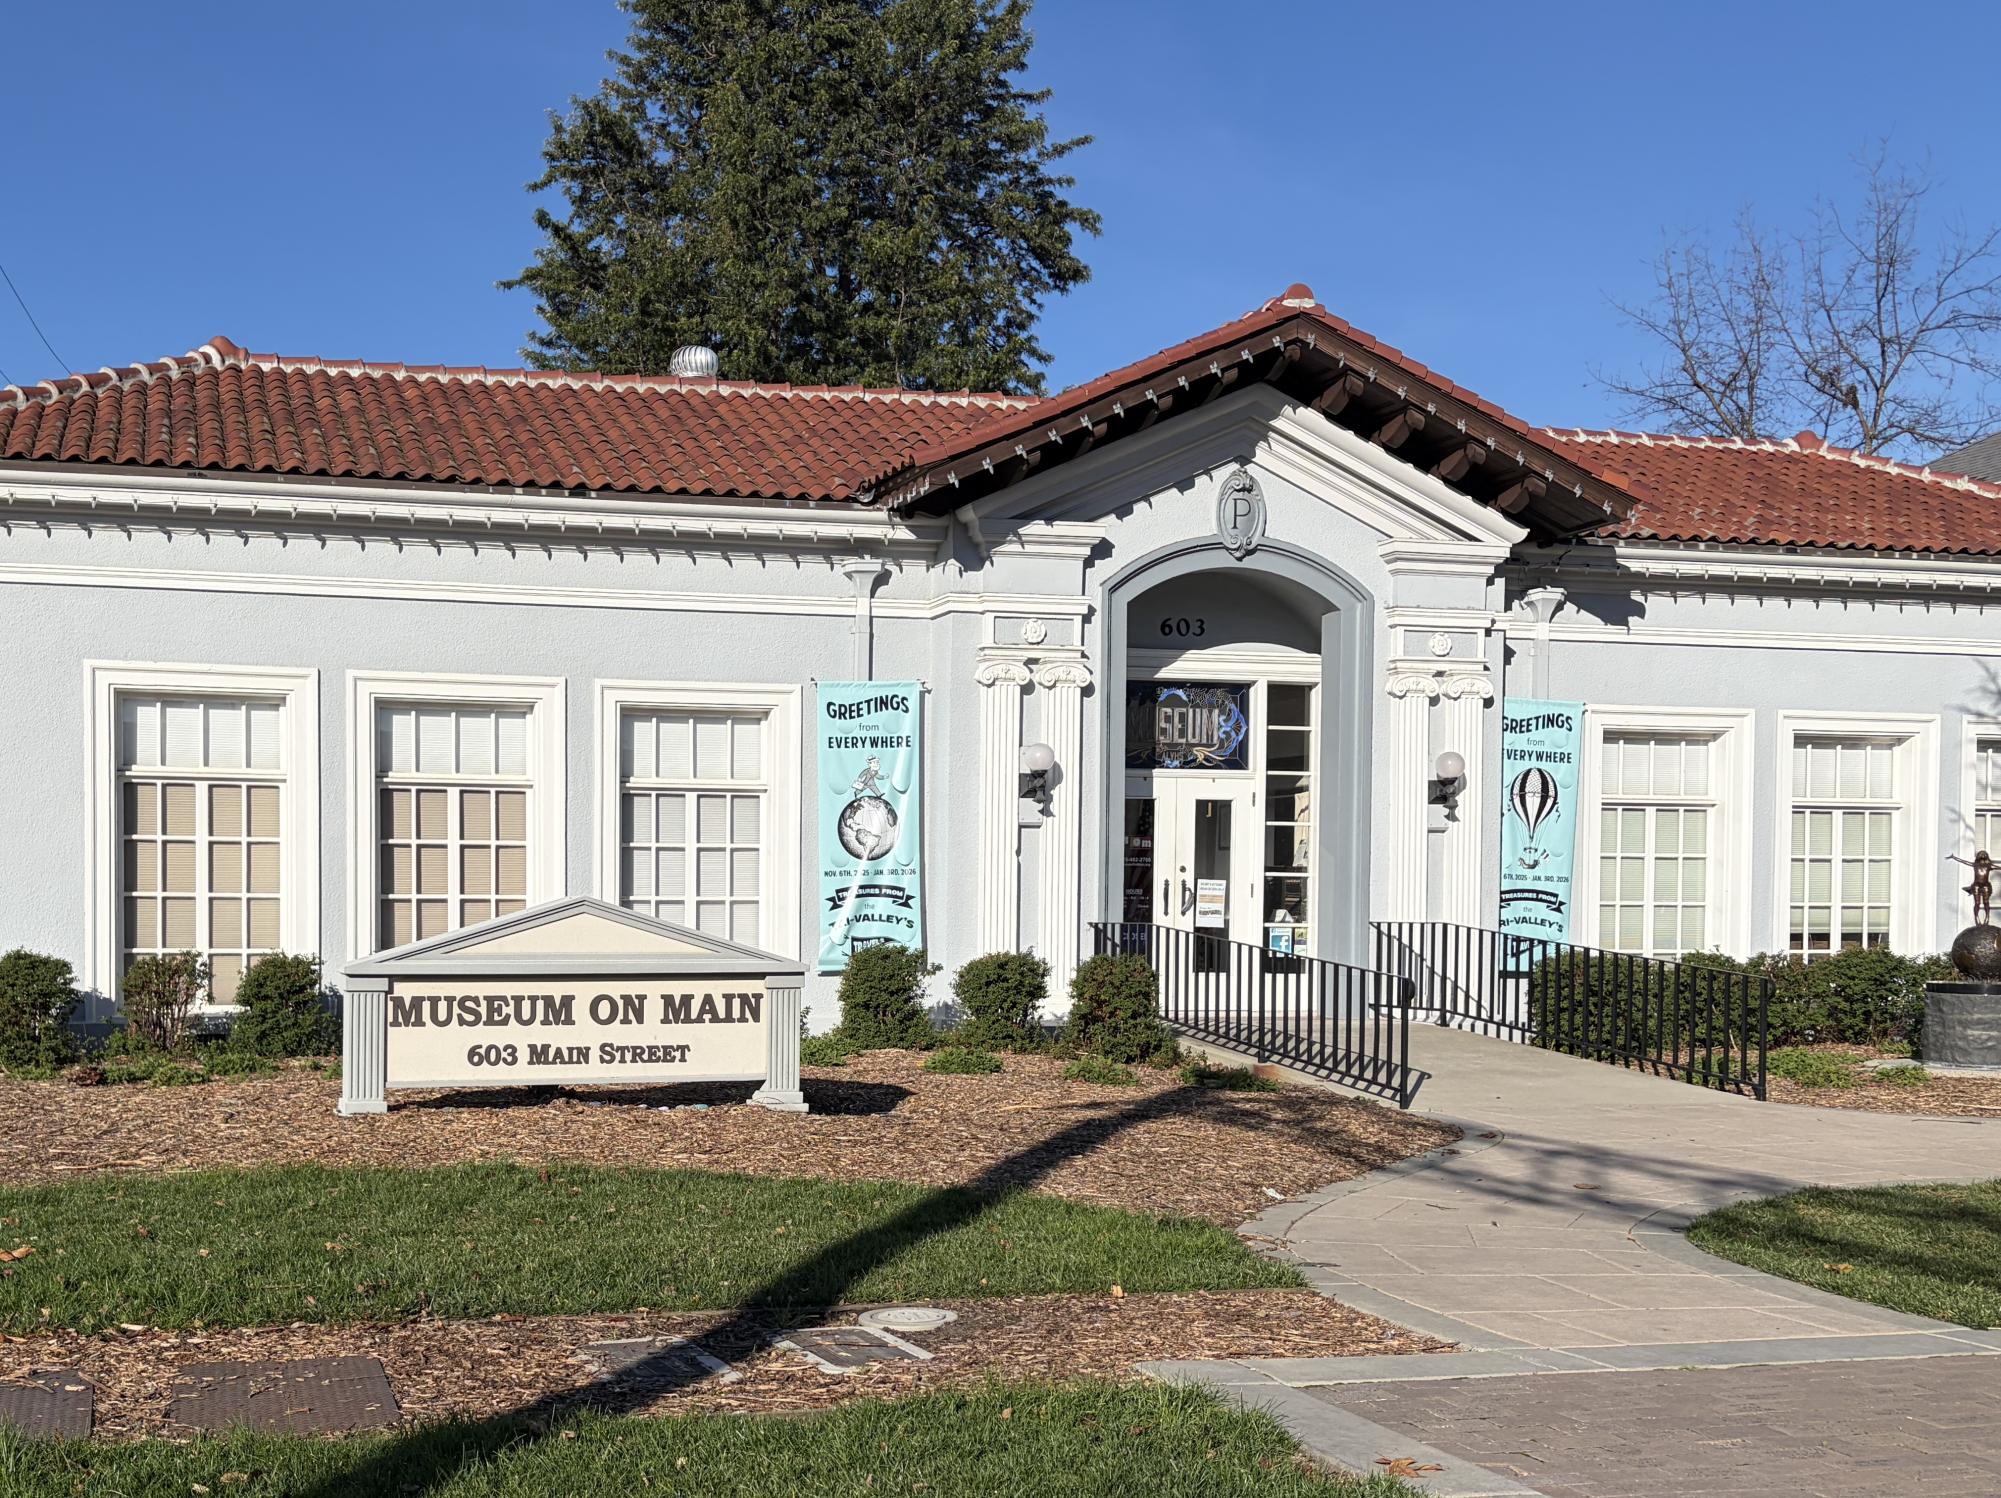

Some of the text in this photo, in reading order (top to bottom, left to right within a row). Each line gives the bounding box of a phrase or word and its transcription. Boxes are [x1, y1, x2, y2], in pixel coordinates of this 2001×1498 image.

[1231, 498, 1252, 530] P
[1160, 617, 1206, 637] 603
[826, 694, 910, 720] GREETINGS
[859, 722, 880, 732] from
[828, 735, 912, 749] EVERYWHERE
[1526, 737, 1546, 747] from
[1502, 748, 1573, 764] VERYWHERE
[824, 870, 837, 878] NOV.
[853, 869, 870, 877] 225
[901, 868, 917, 876] 2026
[838, 888, 903, 898] TRSURES FROM
[1501, 892, 1557, 902] TREASURES FROM
[828, 913, 915, 929] I-VALLEY'S
[1500, 916, 1564, 933] RI-VALLEY'S
[389, 992, 764, 1028] MUSEUM ON MAIN
[467, 1044, 519, 1067] 603
